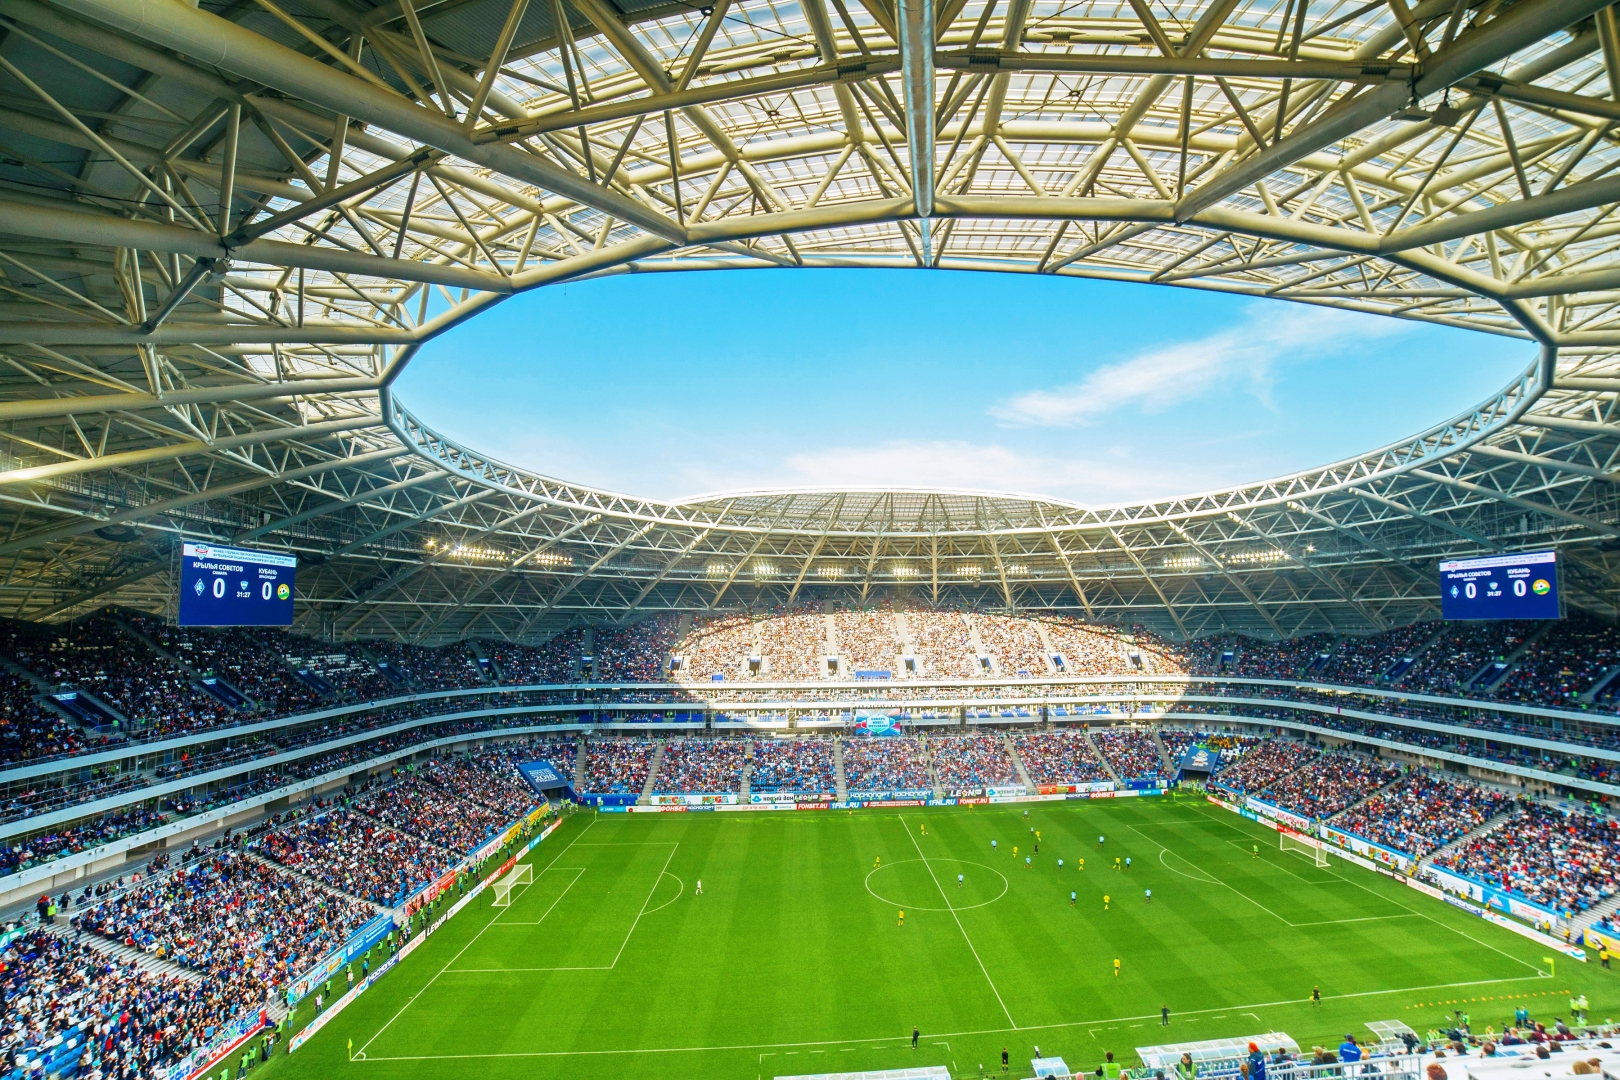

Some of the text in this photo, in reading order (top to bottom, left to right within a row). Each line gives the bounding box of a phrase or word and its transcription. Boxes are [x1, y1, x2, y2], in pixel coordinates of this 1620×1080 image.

[193, 562, 244, 572] КРЫЛЬЯ СОВЕТОВ
[258, 568, 278, 576] КУБАНЬ
[213, 578, 226, 598] 0
[262, 582, 272, 600] 0
[1465, 582, 1477, 599] 0
[1514, 580, 1526, 597] 0
